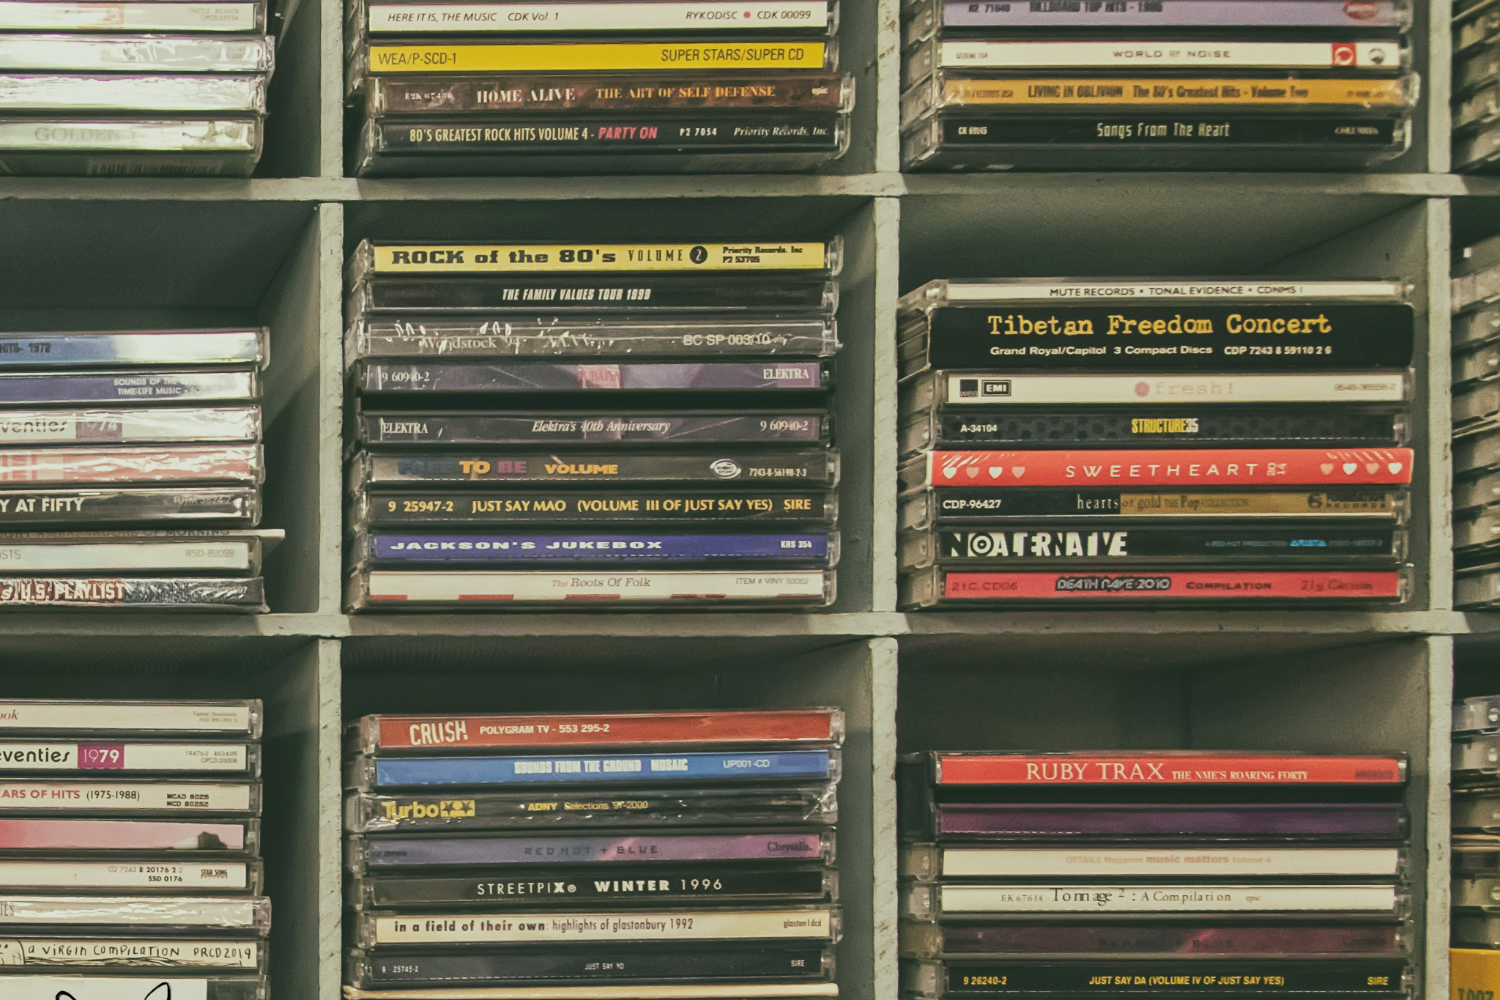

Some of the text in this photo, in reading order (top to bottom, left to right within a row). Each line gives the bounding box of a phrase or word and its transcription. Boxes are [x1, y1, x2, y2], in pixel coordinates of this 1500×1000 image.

[379, 48, 804, 64] WEA/P-SCD-1 SUPER STARS/SUPER CD
[1097, 123, 1229, 139] Songs From The Heart
[392, 248, 702, 264] ROCK of the 80's VOLUME 2
[988, 314, 1331, 335] Tibetan Freedom Concert
[990, 347, 1026, 355] Grand
[1030, 346, 1106, 356] Royal/Capitol
[1125, 346, 1177, 355] Compact
[985, 383, 1008, 393] EMI
[961, 424, 997, 432] A-34104
[1066, 464, 1258, 477] SWEETHEART
[15, 499, 35, 512] AT
[42, 498, 84, 512] FIFTY
[480, 726, 534, 734] POLYGRAM
[537, 725, 549, 733] TV
[559, 724, 578, 733] 553
[581, 724, 610, 733] 295-2
[84, 750, 119, 763] 1979
[1027, 763, 1163, 779] RUBY TRAX
[594, 879, 721, 892] WINTER 1996
